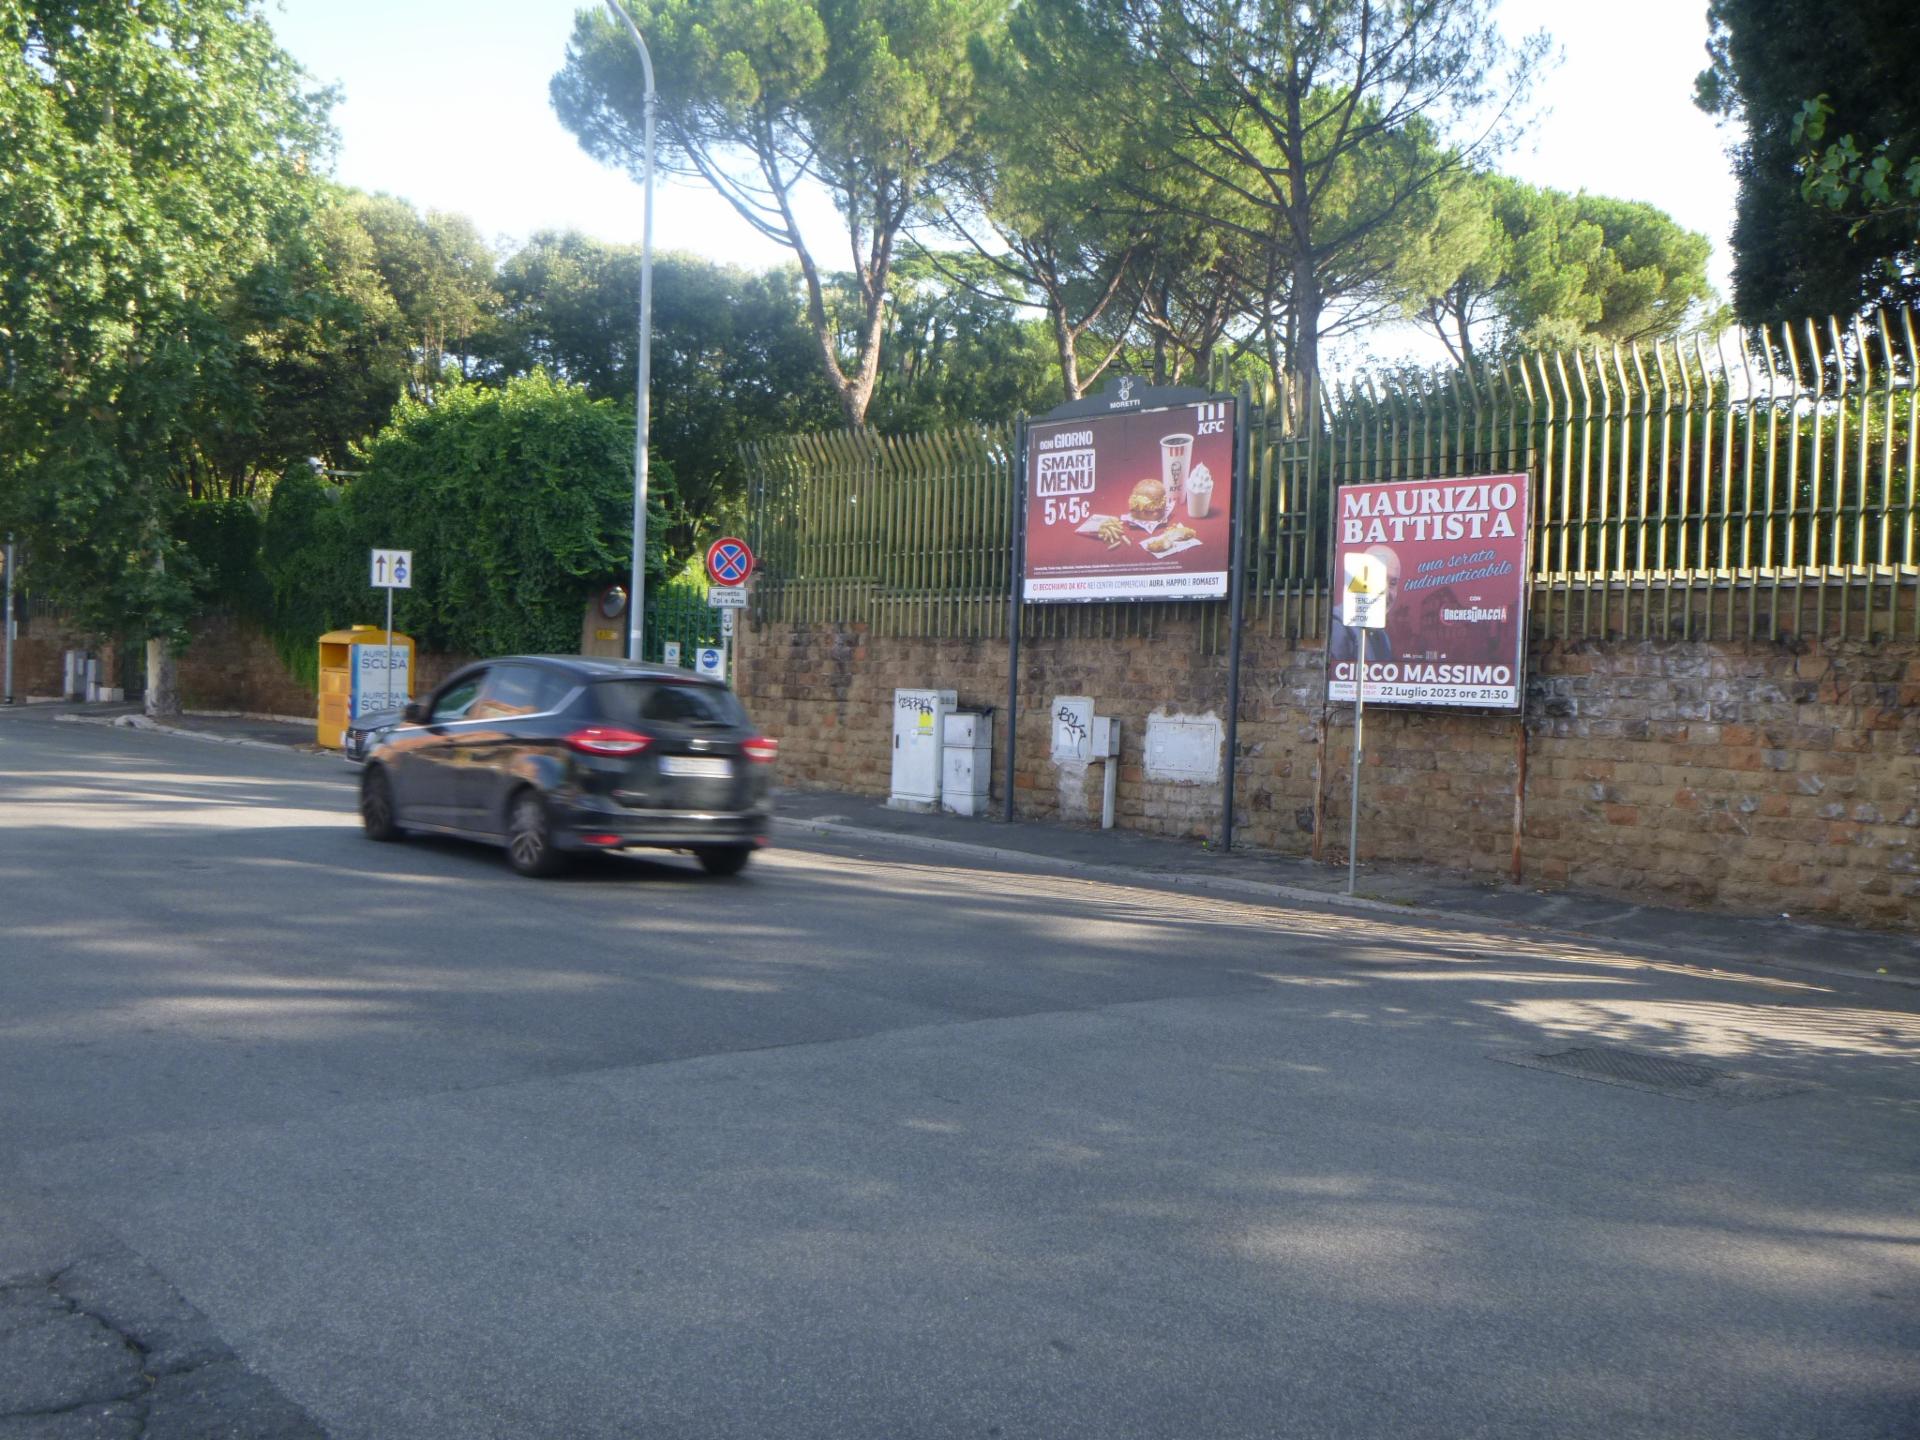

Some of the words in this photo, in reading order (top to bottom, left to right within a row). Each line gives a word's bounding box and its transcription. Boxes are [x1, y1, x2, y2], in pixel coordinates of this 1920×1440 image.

[1110, 399, 1140, 409] MORETTI
[1198, 420, 1225, 435] KFC
[1040, 440, 1054, 450] OGNI
[1054, 431, 1093, 448] GIORNO
[1042, 454, 1093, 471] SMART
[1343, 483, 1517, 519] MAURIZIO
[1343, 511, 1515, 544] BATTISTA
[1417, 560, 1445, 573] una
[1447, 549, 1496, 567] serata
[1076, 582, 1087, 590] KFC
[1166, 578, 1187, 587] HAPPIO
[1192, 577, 1219, 586] ROMAEST
[1404, 560, 1513, 592] indimenticabile
[1335, 662, 1399, 681] CIRCO
[1404, 664, 1510, 684] MASSIMO
[1381, 686, 1393, 696] 22
[1396, 686, 1427, 699] Luglio
[1430, 688, 1457, 698] 2023
[1459, 690, 1477, 698] ore
[1480, 689, 1508, 700] 21:30
